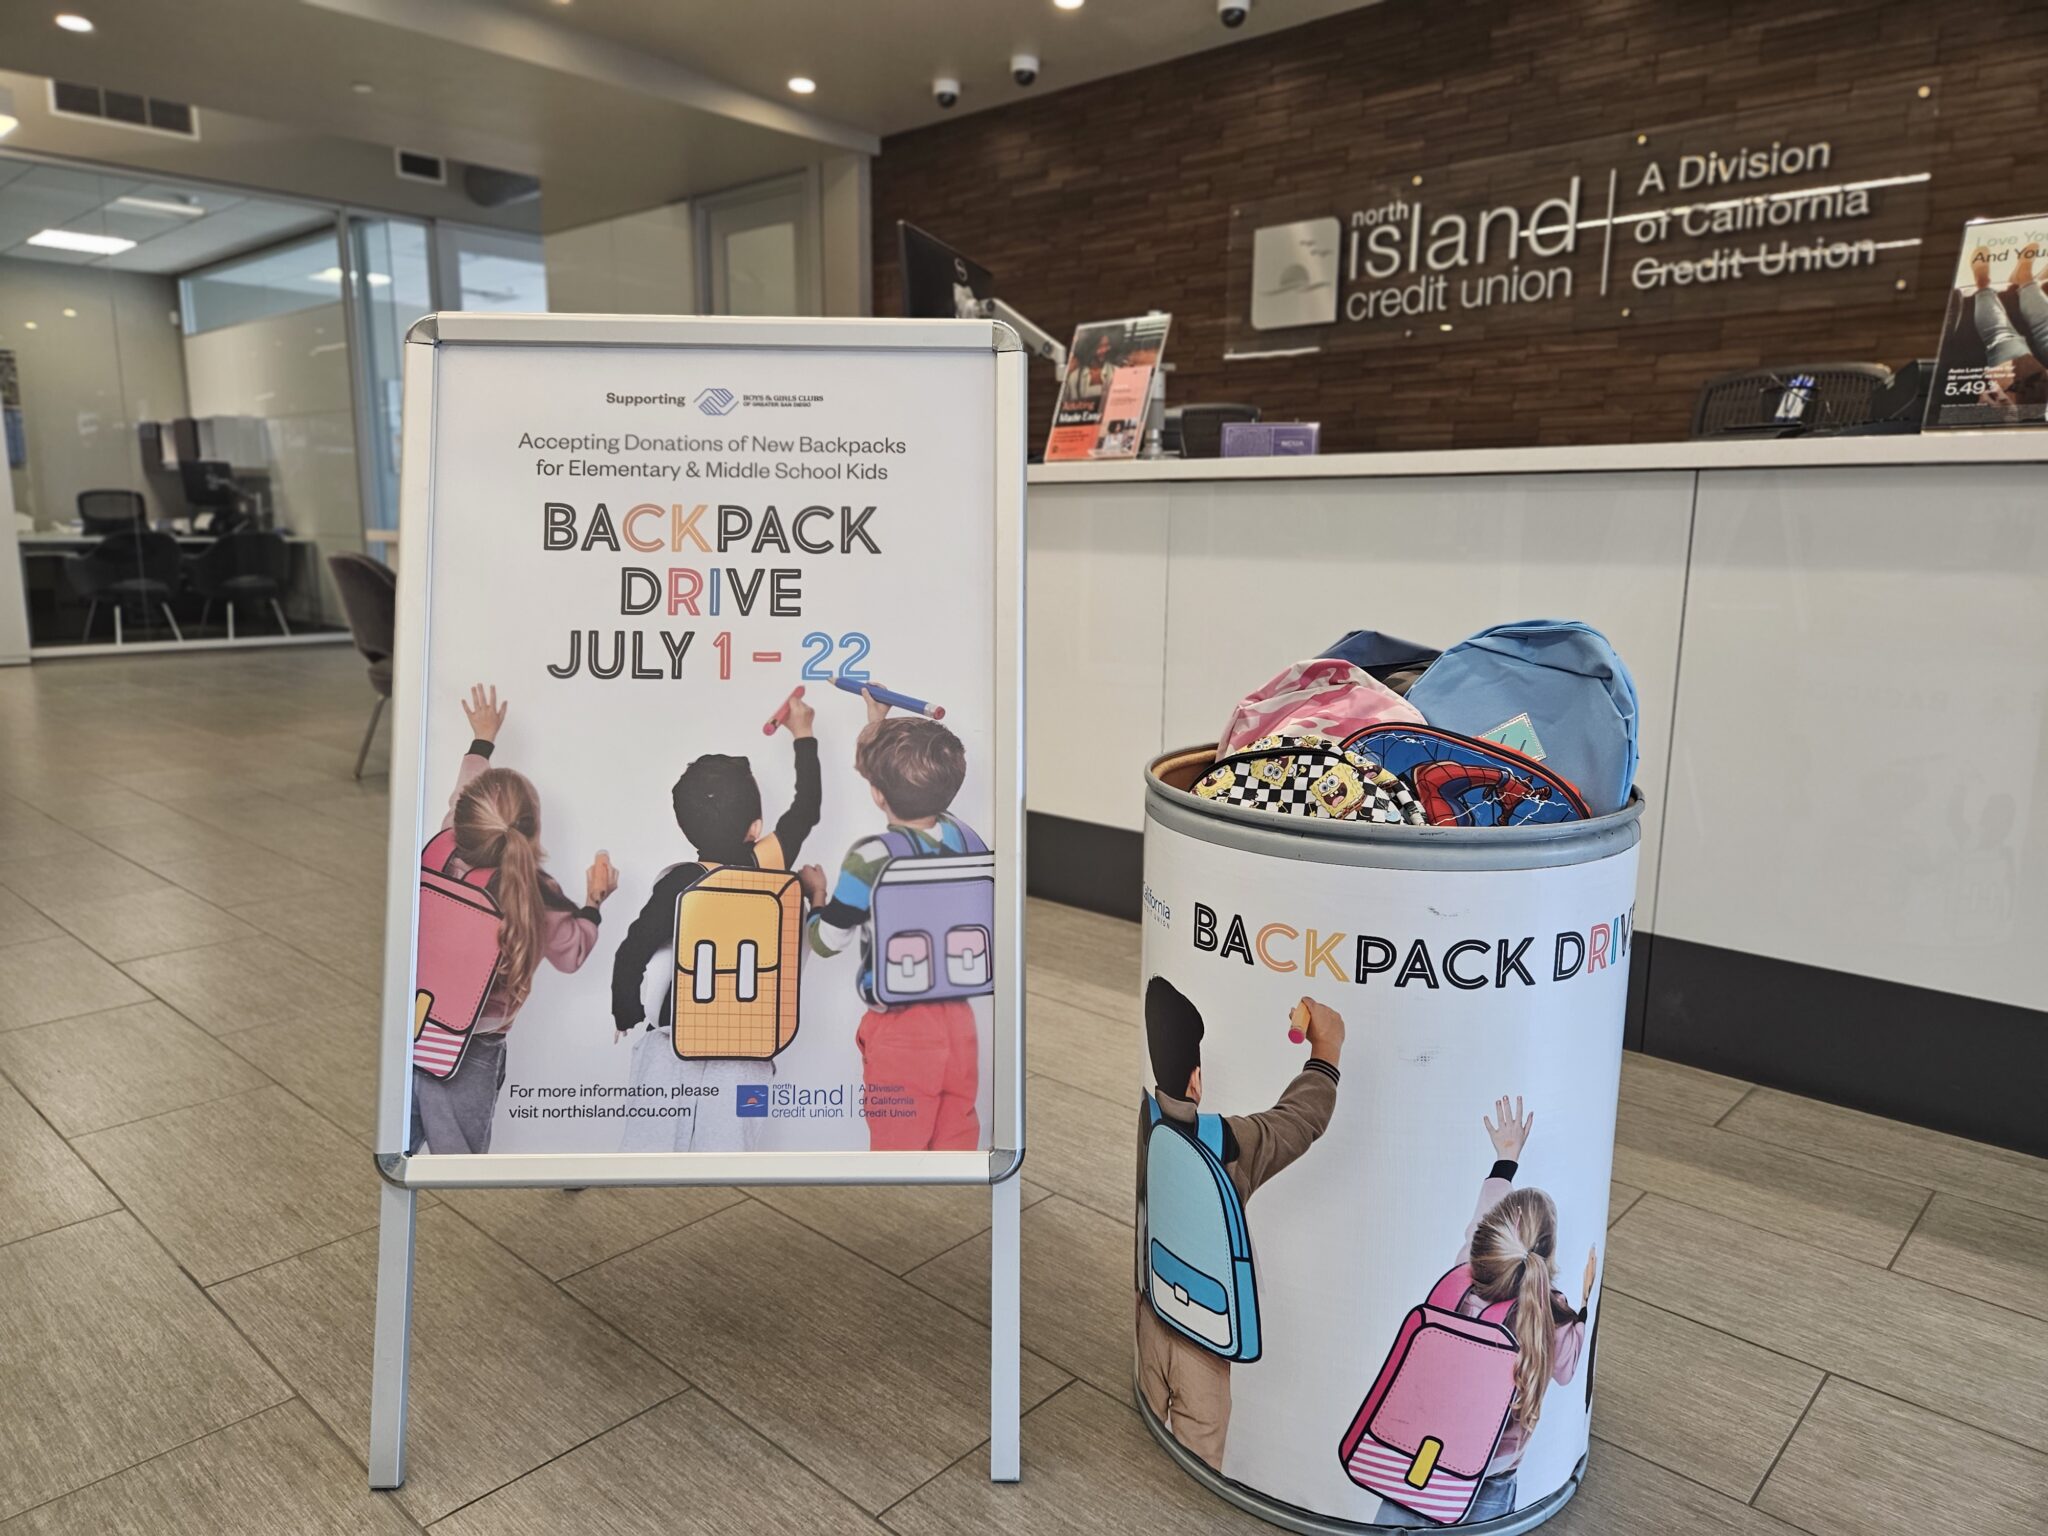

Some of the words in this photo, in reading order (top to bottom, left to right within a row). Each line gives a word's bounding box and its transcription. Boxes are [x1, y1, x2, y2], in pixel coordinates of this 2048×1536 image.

[1637, 162, 1665, 195] A
[1678, 142, 1831, 190] Division
[1352, 200, 1409, 227] north
[1634, 208, 1671, 243] of
[1682, 188, 1870, 236] California
[1349, 175, 1580, 279] island
[2024, 231, 2048, 243] Yo
[1632, 249, 1743, 290] Credit
[1758, 237, 1876, 276] Union
[1972, 248, 2010, 264] And
[2014, 247, 2048, 260] You
[1346, 275, 1448, 321] credit
[1460, 265, 1573, 309] union
[606, 392, 686, 408] Supporting
[518, 432, 620, 455] Accepting
[624, 433, 723, 453] Donations
[728, 434, 749, 453] of
[752, 436, 795, 453] New
[799, 435, 906, 456] Backpacks
[536, 458, 564, 477] for
[568, 459, 681, 481] Elementary
[685, 462, 701, 478] &
[705, 461, 770, 479] Middle
[775, 462, 842, 480] School
[846, 462, 889, 481] Kids
[543, 502, 882, 555] BACKPACK
[620, 566, 802, 617] DRIVE
[546, 630, 696, 680] JULY
[712, 631, 732, 680] 1
[801, 631, 871, 681] 22
[1193, 901, 1536, 990] BACKPACK
[510, 1084, 535, 1098] For
[537, 1086, 576, 1098] more
[579, 1084, 668, 1099] information,
[671, 1083, 720, 1100] please
[772, 1084, 844, 1106] island
[858, 1084, 866, 1092] A
[868, 1083, 905, 1092] Division
[509, 1105, 539, 1118] visit
[541, 1104, 691, 1119] northisland.ccu.com
[771, 1105, 805, 1118] credit
[809, 1106, 843, 1118] union
[858, 1096, 869, 1105] of
[870, 1096, 914, 1105] California
[858, 1108, 887, 1118] Credit
[888, 1108, 917, 1118] Union
